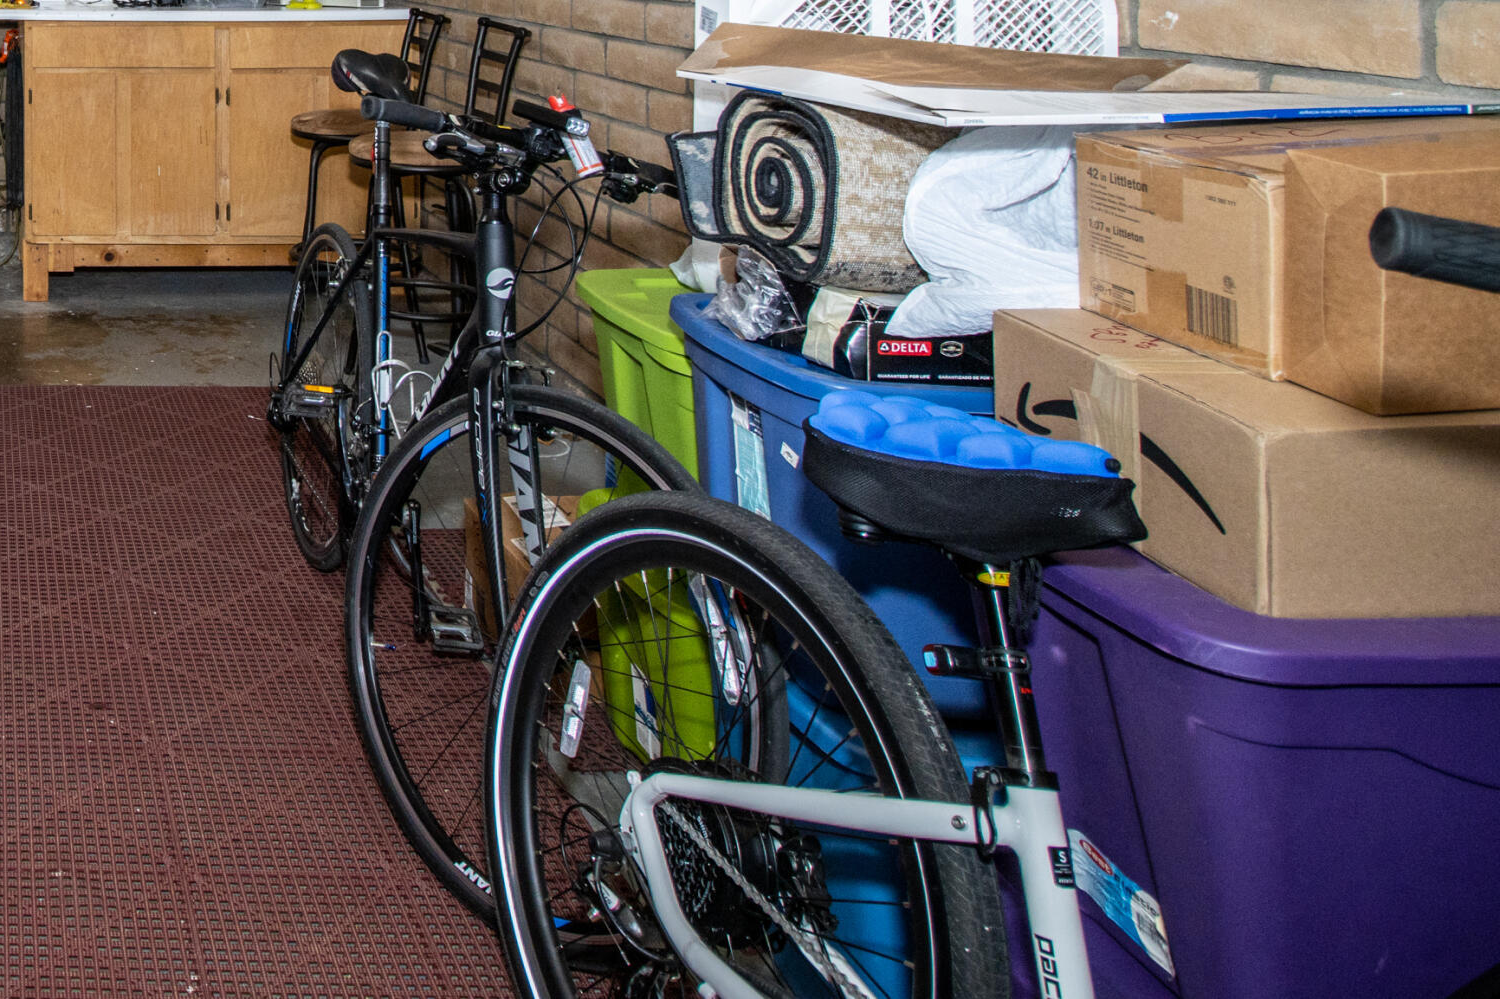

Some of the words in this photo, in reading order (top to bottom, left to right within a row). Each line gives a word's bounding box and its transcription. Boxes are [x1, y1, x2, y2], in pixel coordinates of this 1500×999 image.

[1109, 171, 1148, 193] Littleton
[1112, 225, 1145, 243] Littleton
[891, 342, 929, 353] DELTA
